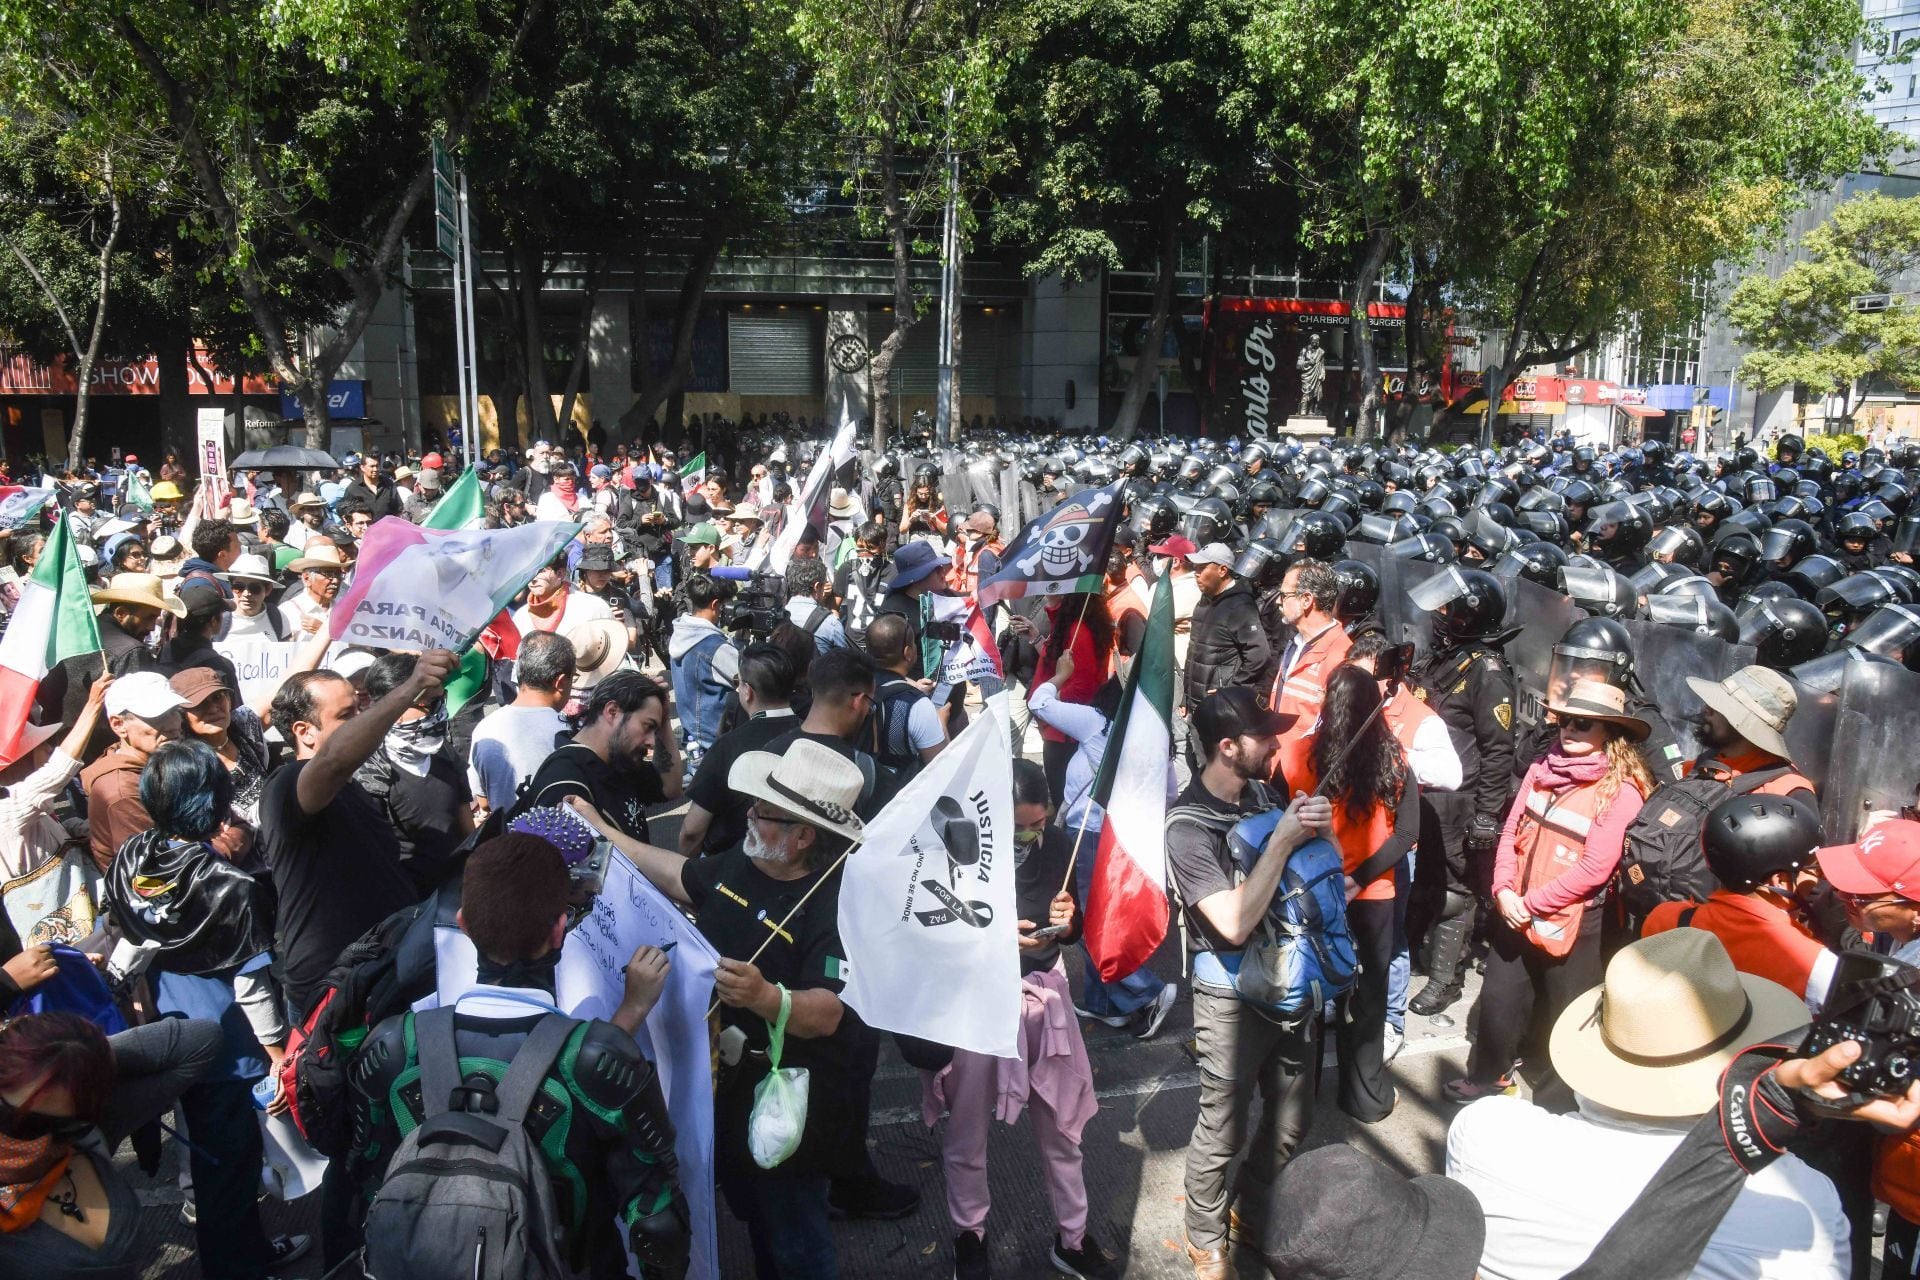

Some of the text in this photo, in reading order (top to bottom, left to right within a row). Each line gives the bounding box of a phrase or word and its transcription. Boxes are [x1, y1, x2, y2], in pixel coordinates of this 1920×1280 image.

[245, 419, 281, 429] Reform
[969, 790, 994, 884] JUSTICIA
[901, 896, 914, 923] RINDE
[934, 885, 963, 915] POR LA
[928, 913, 948, 925] PAZ
[1730, 1084, 1762, 1158] Canon
